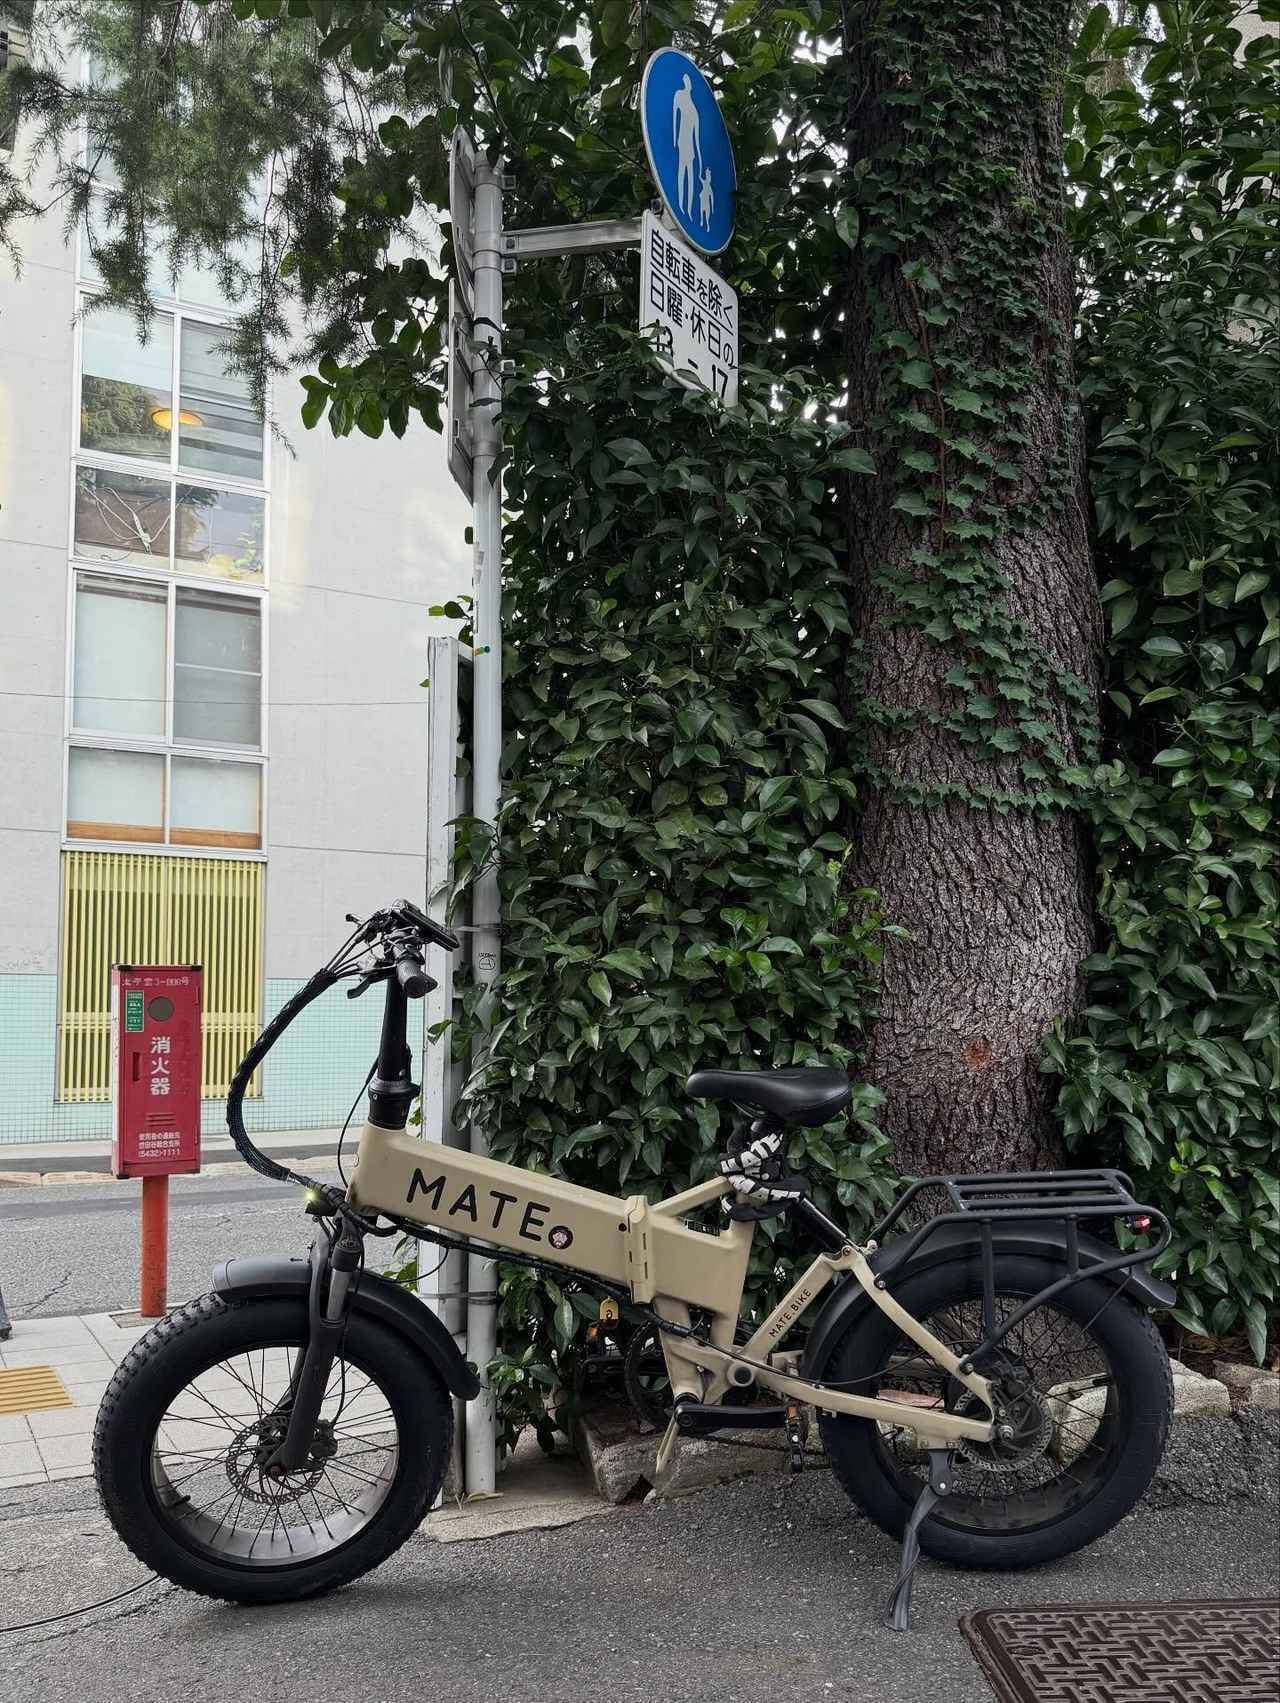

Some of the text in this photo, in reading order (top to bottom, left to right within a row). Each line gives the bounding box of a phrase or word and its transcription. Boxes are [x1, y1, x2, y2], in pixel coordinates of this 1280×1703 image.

[651, 229, 733, 329] 自転車を除く
[712, 364, 729, 399] 17
[151, 1036, 170, 1095] 消火器
